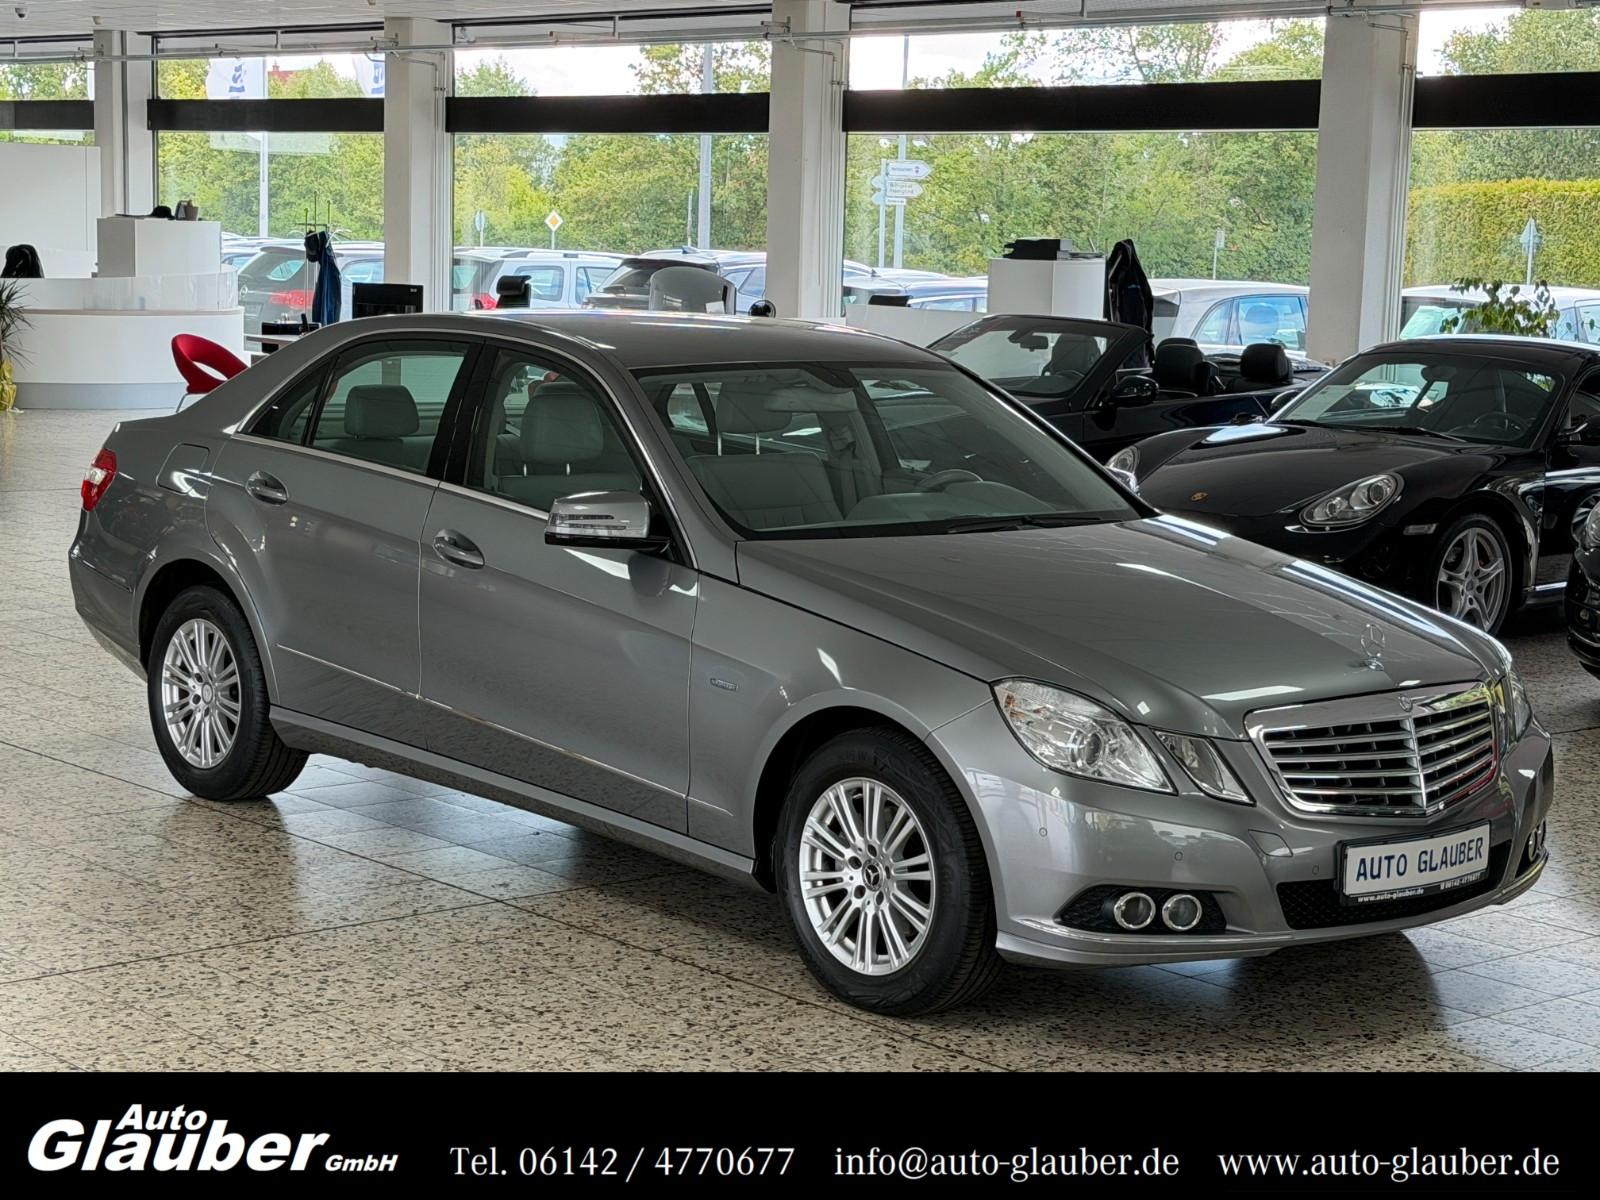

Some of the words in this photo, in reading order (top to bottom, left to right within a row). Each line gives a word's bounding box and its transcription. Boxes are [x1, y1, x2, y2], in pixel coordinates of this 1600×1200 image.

[1356, 853, 1408, 882] AUTO
[1417, 837, 1483, 873] GLAUBER
[1358, 888, 1424, 903] www.auto-glauber.de
